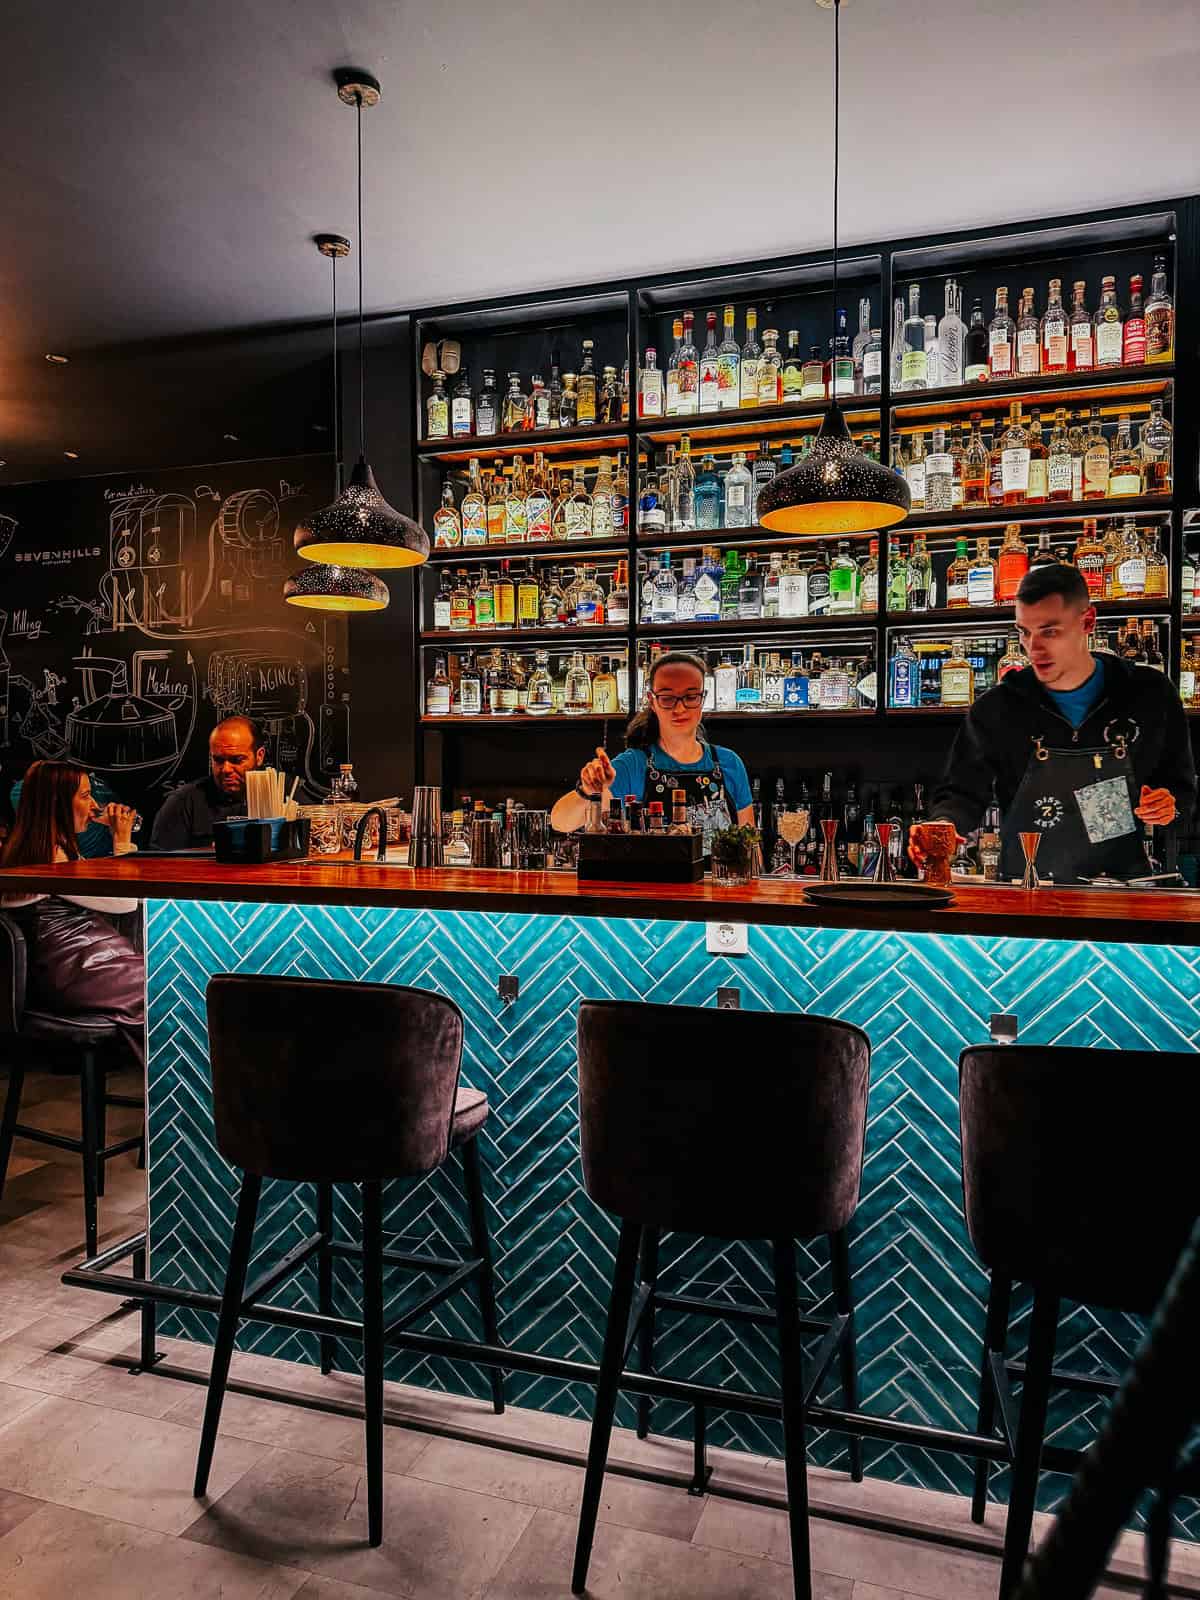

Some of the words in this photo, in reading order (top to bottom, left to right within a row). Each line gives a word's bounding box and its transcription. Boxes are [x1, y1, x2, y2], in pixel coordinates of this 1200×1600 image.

[15, 547, 101, 562] SEVENHILLS
[12, 609, 42, 639] Milling
[146, 666, 189, 710] Mashing
[259, 666, 295, 693] AGING
